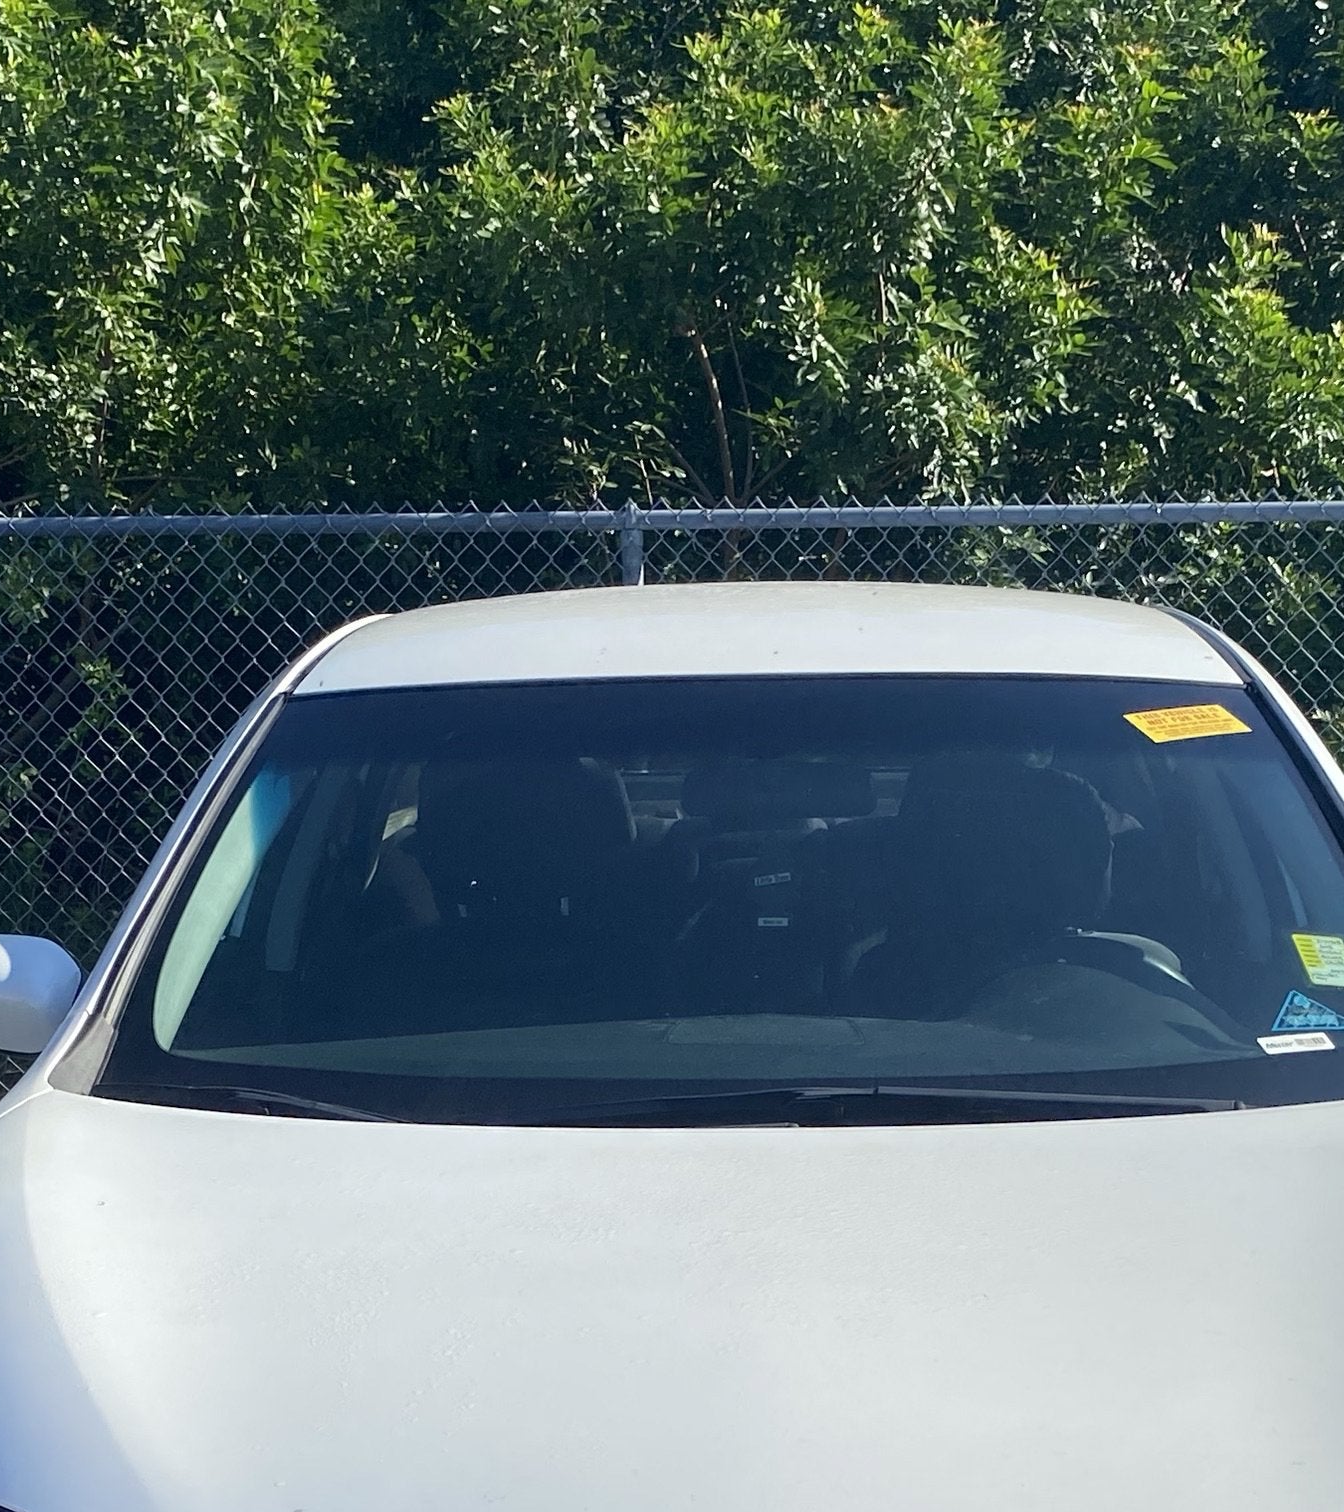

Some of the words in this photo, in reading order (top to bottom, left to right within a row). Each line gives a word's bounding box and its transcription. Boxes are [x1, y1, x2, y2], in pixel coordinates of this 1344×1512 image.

[1135, 711, 1156, 720] THIS
[1162, 707, 1203, 717] VEHICLE
[1147, 717, 1167, 726] NOT
[1172, 715, 1192, 723] FOR
[1196, 712, 1220, 720] SALE
